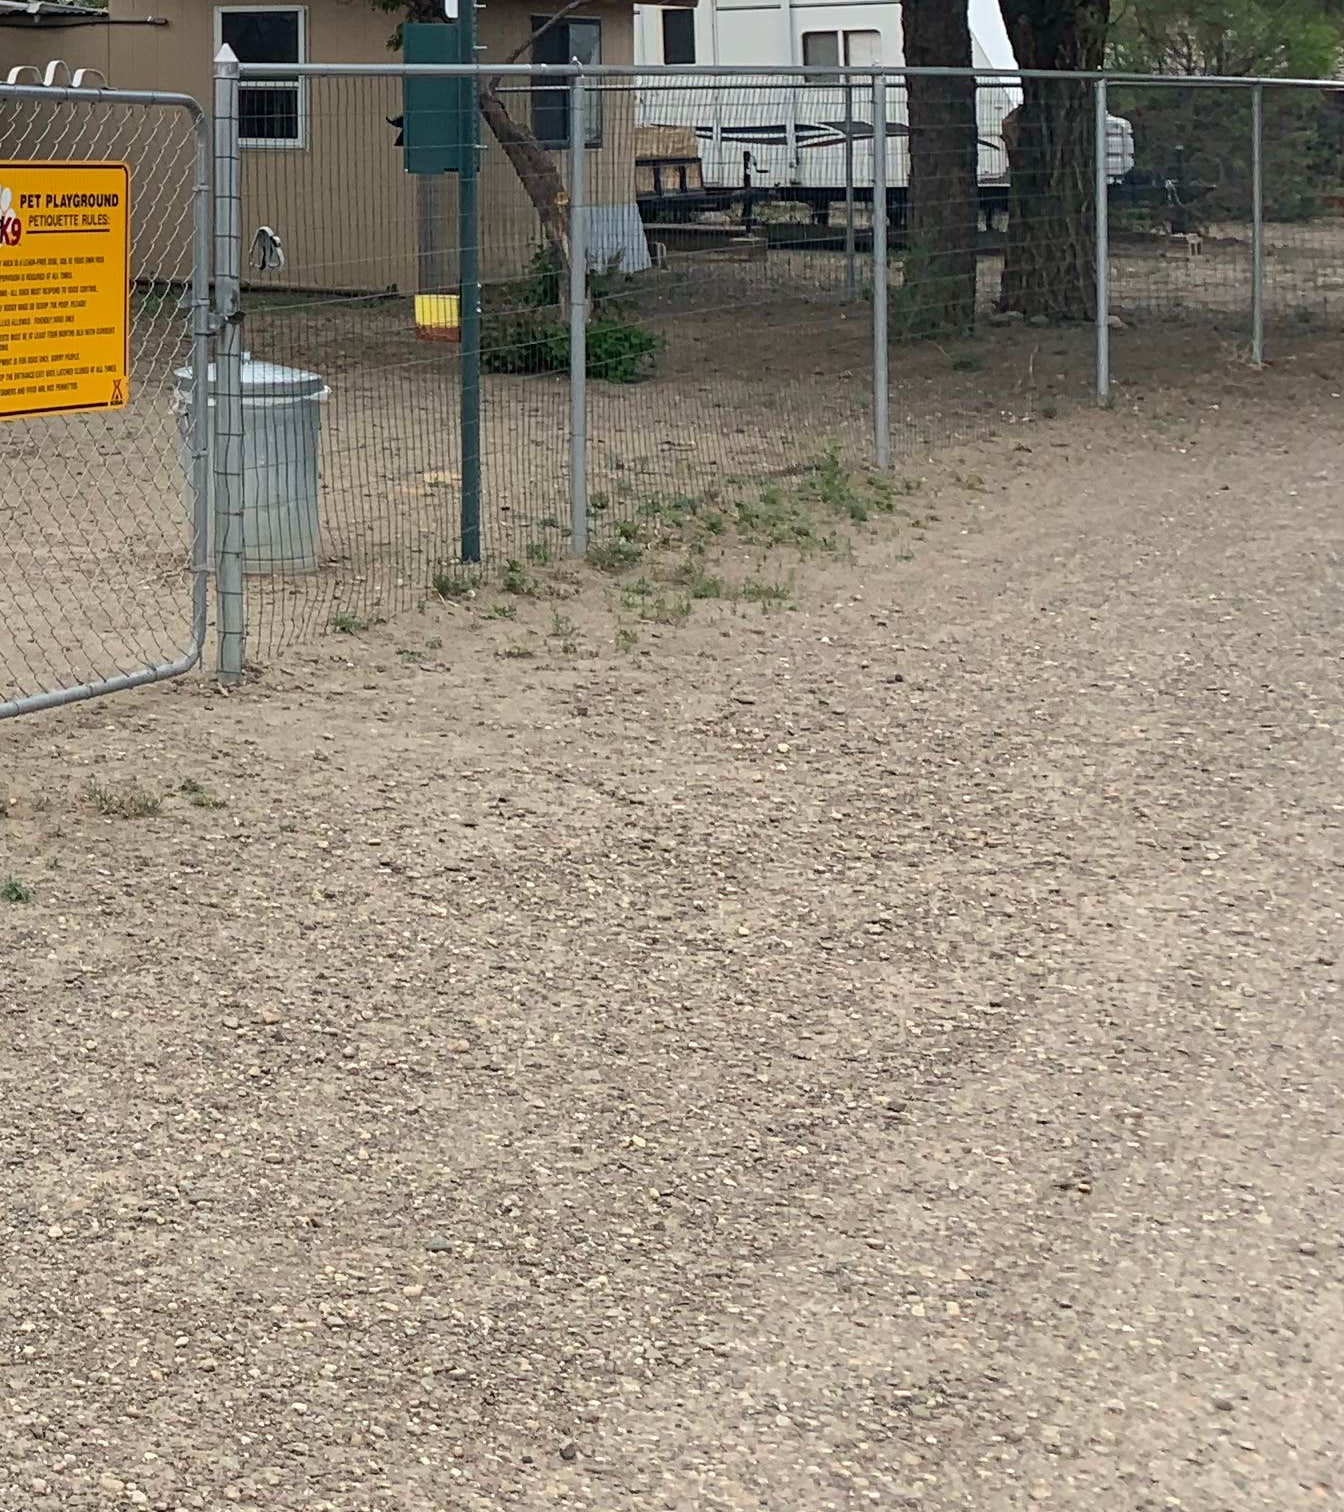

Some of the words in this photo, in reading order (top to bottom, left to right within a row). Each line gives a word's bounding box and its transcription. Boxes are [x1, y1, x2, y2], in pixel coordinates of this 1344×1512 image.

[20, 194, 41, 208] PET
[46, 194, 119, 208] PLAYGROUND
[29, 214, 78, 226] PETIQUETTE
[0, 216, 21, 246] K9
